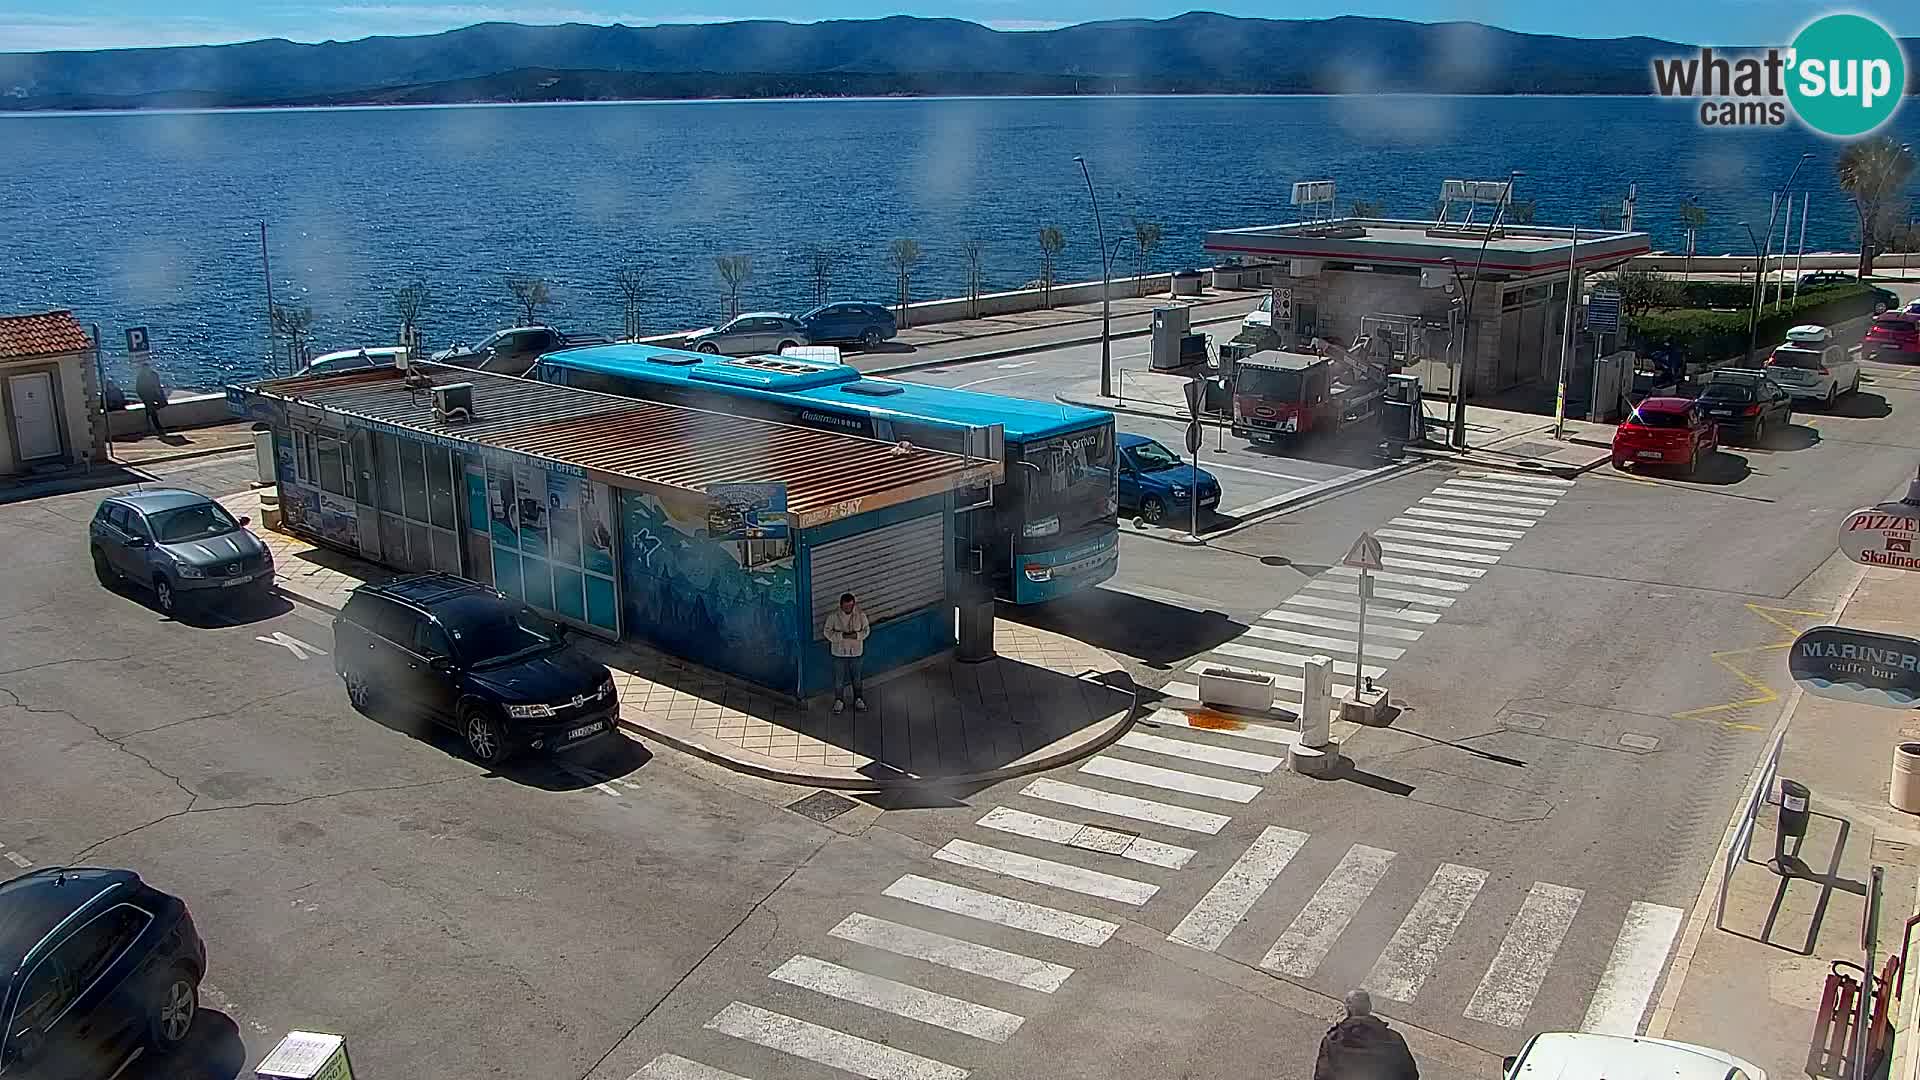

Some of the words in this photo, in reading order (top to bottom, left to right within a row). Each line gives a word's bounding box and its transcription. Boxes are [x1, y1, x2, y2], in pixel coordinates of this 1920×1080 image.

[130, 331, 143, 350] P
[530, 456, 555, 471] TICKET
[556, 461, 583, 476] OFFICE
[1849, 514, 1920, 534] PIZZE
[1802, 642, 1920, 673] MARINER
[1829, 662, 1867, 674] caffe
[1871, 665, 1898, 680] bar
